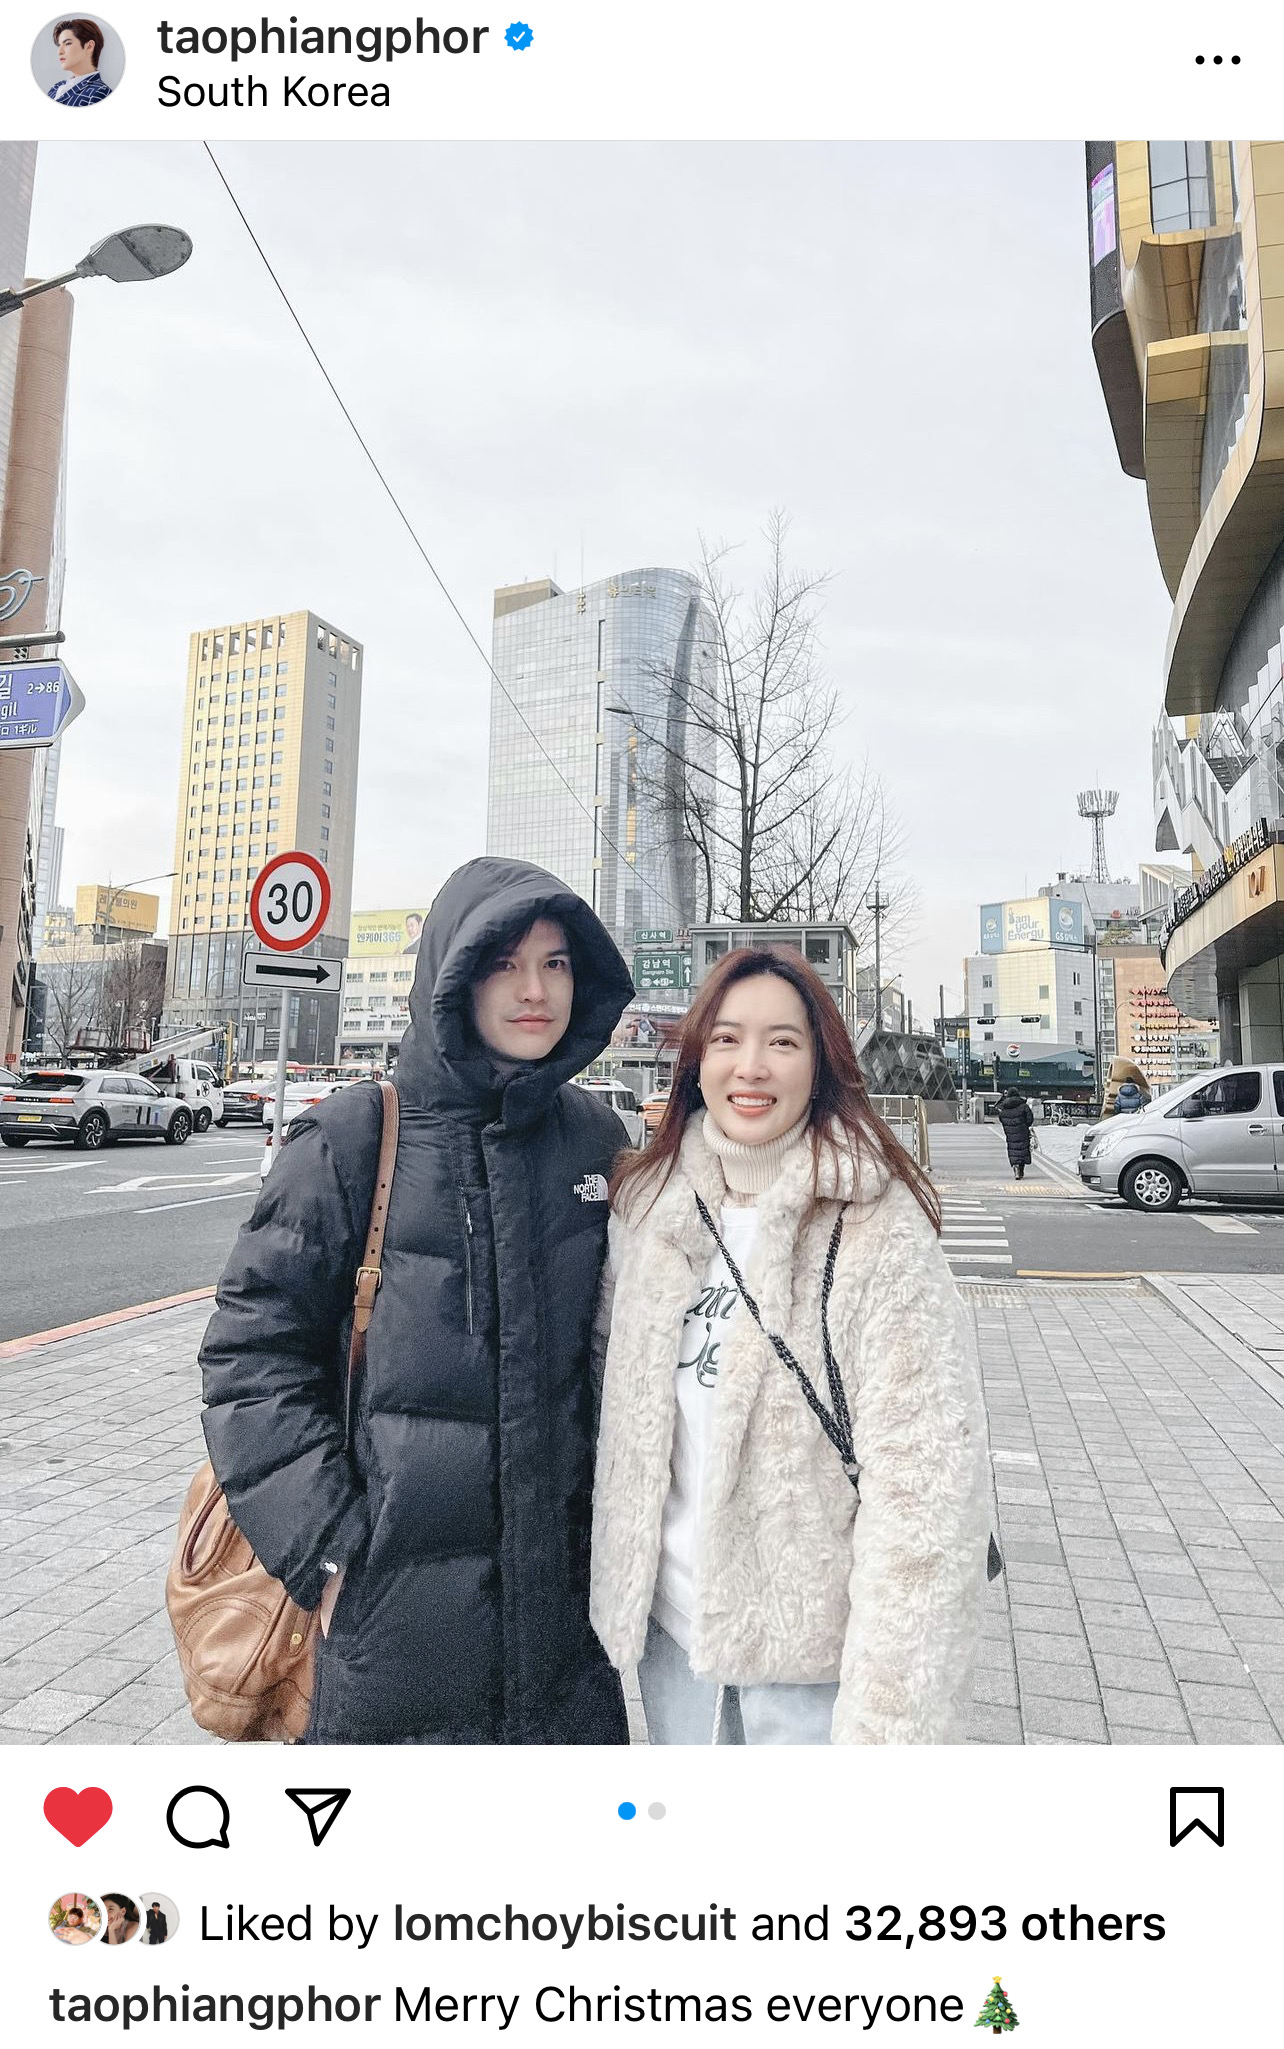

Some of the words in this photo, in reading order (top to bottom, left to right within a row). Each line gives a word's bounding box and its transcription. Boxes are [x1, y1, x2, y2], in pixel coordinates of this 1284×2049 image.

[46, 681, 60, 693] 86
[267, 880, 314, 924] 30
[641, 931, 667, 940] 신사역
[642, 959, 671, 969] 강남역
[583, 1174, 599, 1185] THE
[573, 1183, 598, 1195] NORTH
[581, 1192, 599, 1202] FACE
